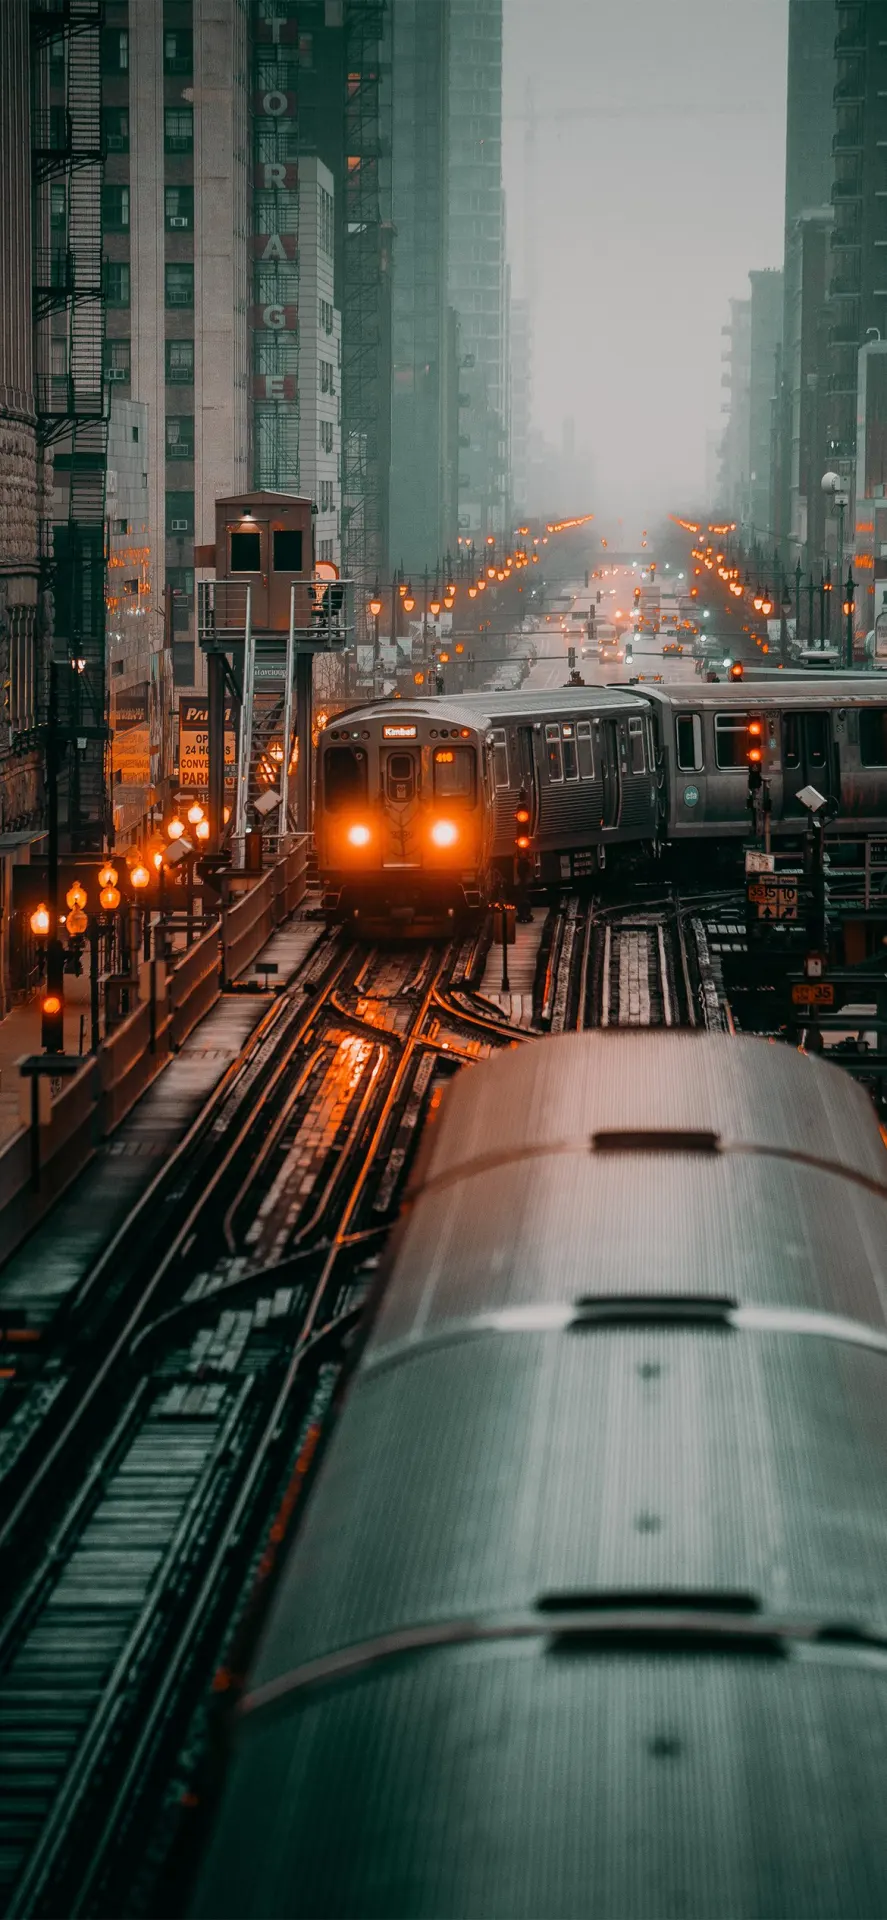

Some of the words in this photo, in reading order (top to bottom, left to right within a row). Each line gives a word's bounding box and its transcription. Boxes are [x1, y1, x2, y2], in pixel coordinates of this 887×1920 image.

[262, 17, 289, 398] TORAGE
[385, 727, 416, 736] Kimball
[185, 746, 196, 754] 24
[782, 889, 795, 899] 10
[815, 986, 831, 998] 35
